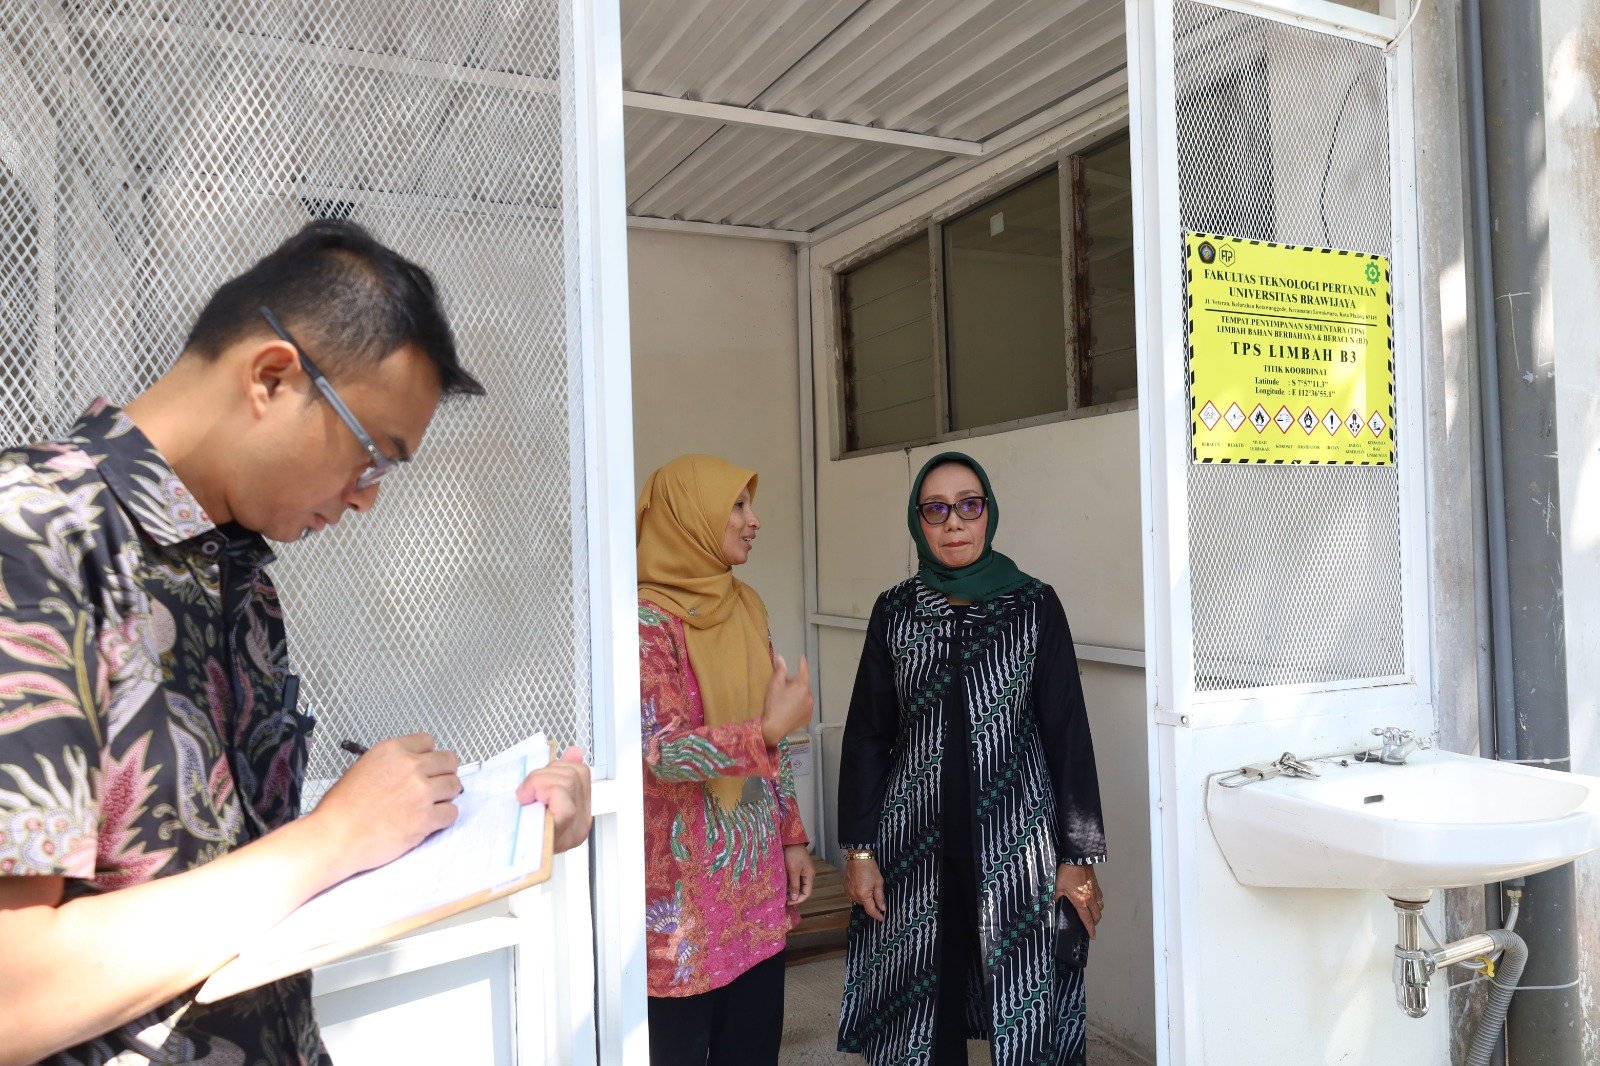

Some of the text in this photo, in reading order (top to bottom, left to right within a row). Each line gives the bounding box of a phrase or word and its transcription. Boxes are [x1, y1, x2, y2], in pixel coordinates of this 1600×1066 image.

[1204, 269, 1376, 297] FAKULTAS TEKNOLOGI PERTANIAN
[1229, 286, 1356, 309] UNIVERSITAS BRAWIJAYA
[1217, 325, 1246, 334] LIMBAH
[1248, 328, 1273, 337] BAHAN
[1274, 330, 1316, 341] BERBAHAYA
[1324, 334, 1355, 344] BERACUN
[1221, 316, 1365, 335] TEMPAT PENYIMPANAN SEMENTARA (TPS)
[1230, 342, 1356, 363] TPS LIMBAH B3
[1264, 365, 1327, 376] TITIK KOORDINAT
[1255, 377, 1280, 386] Latitude
[1255, 386, 1284, 396] Longitude
